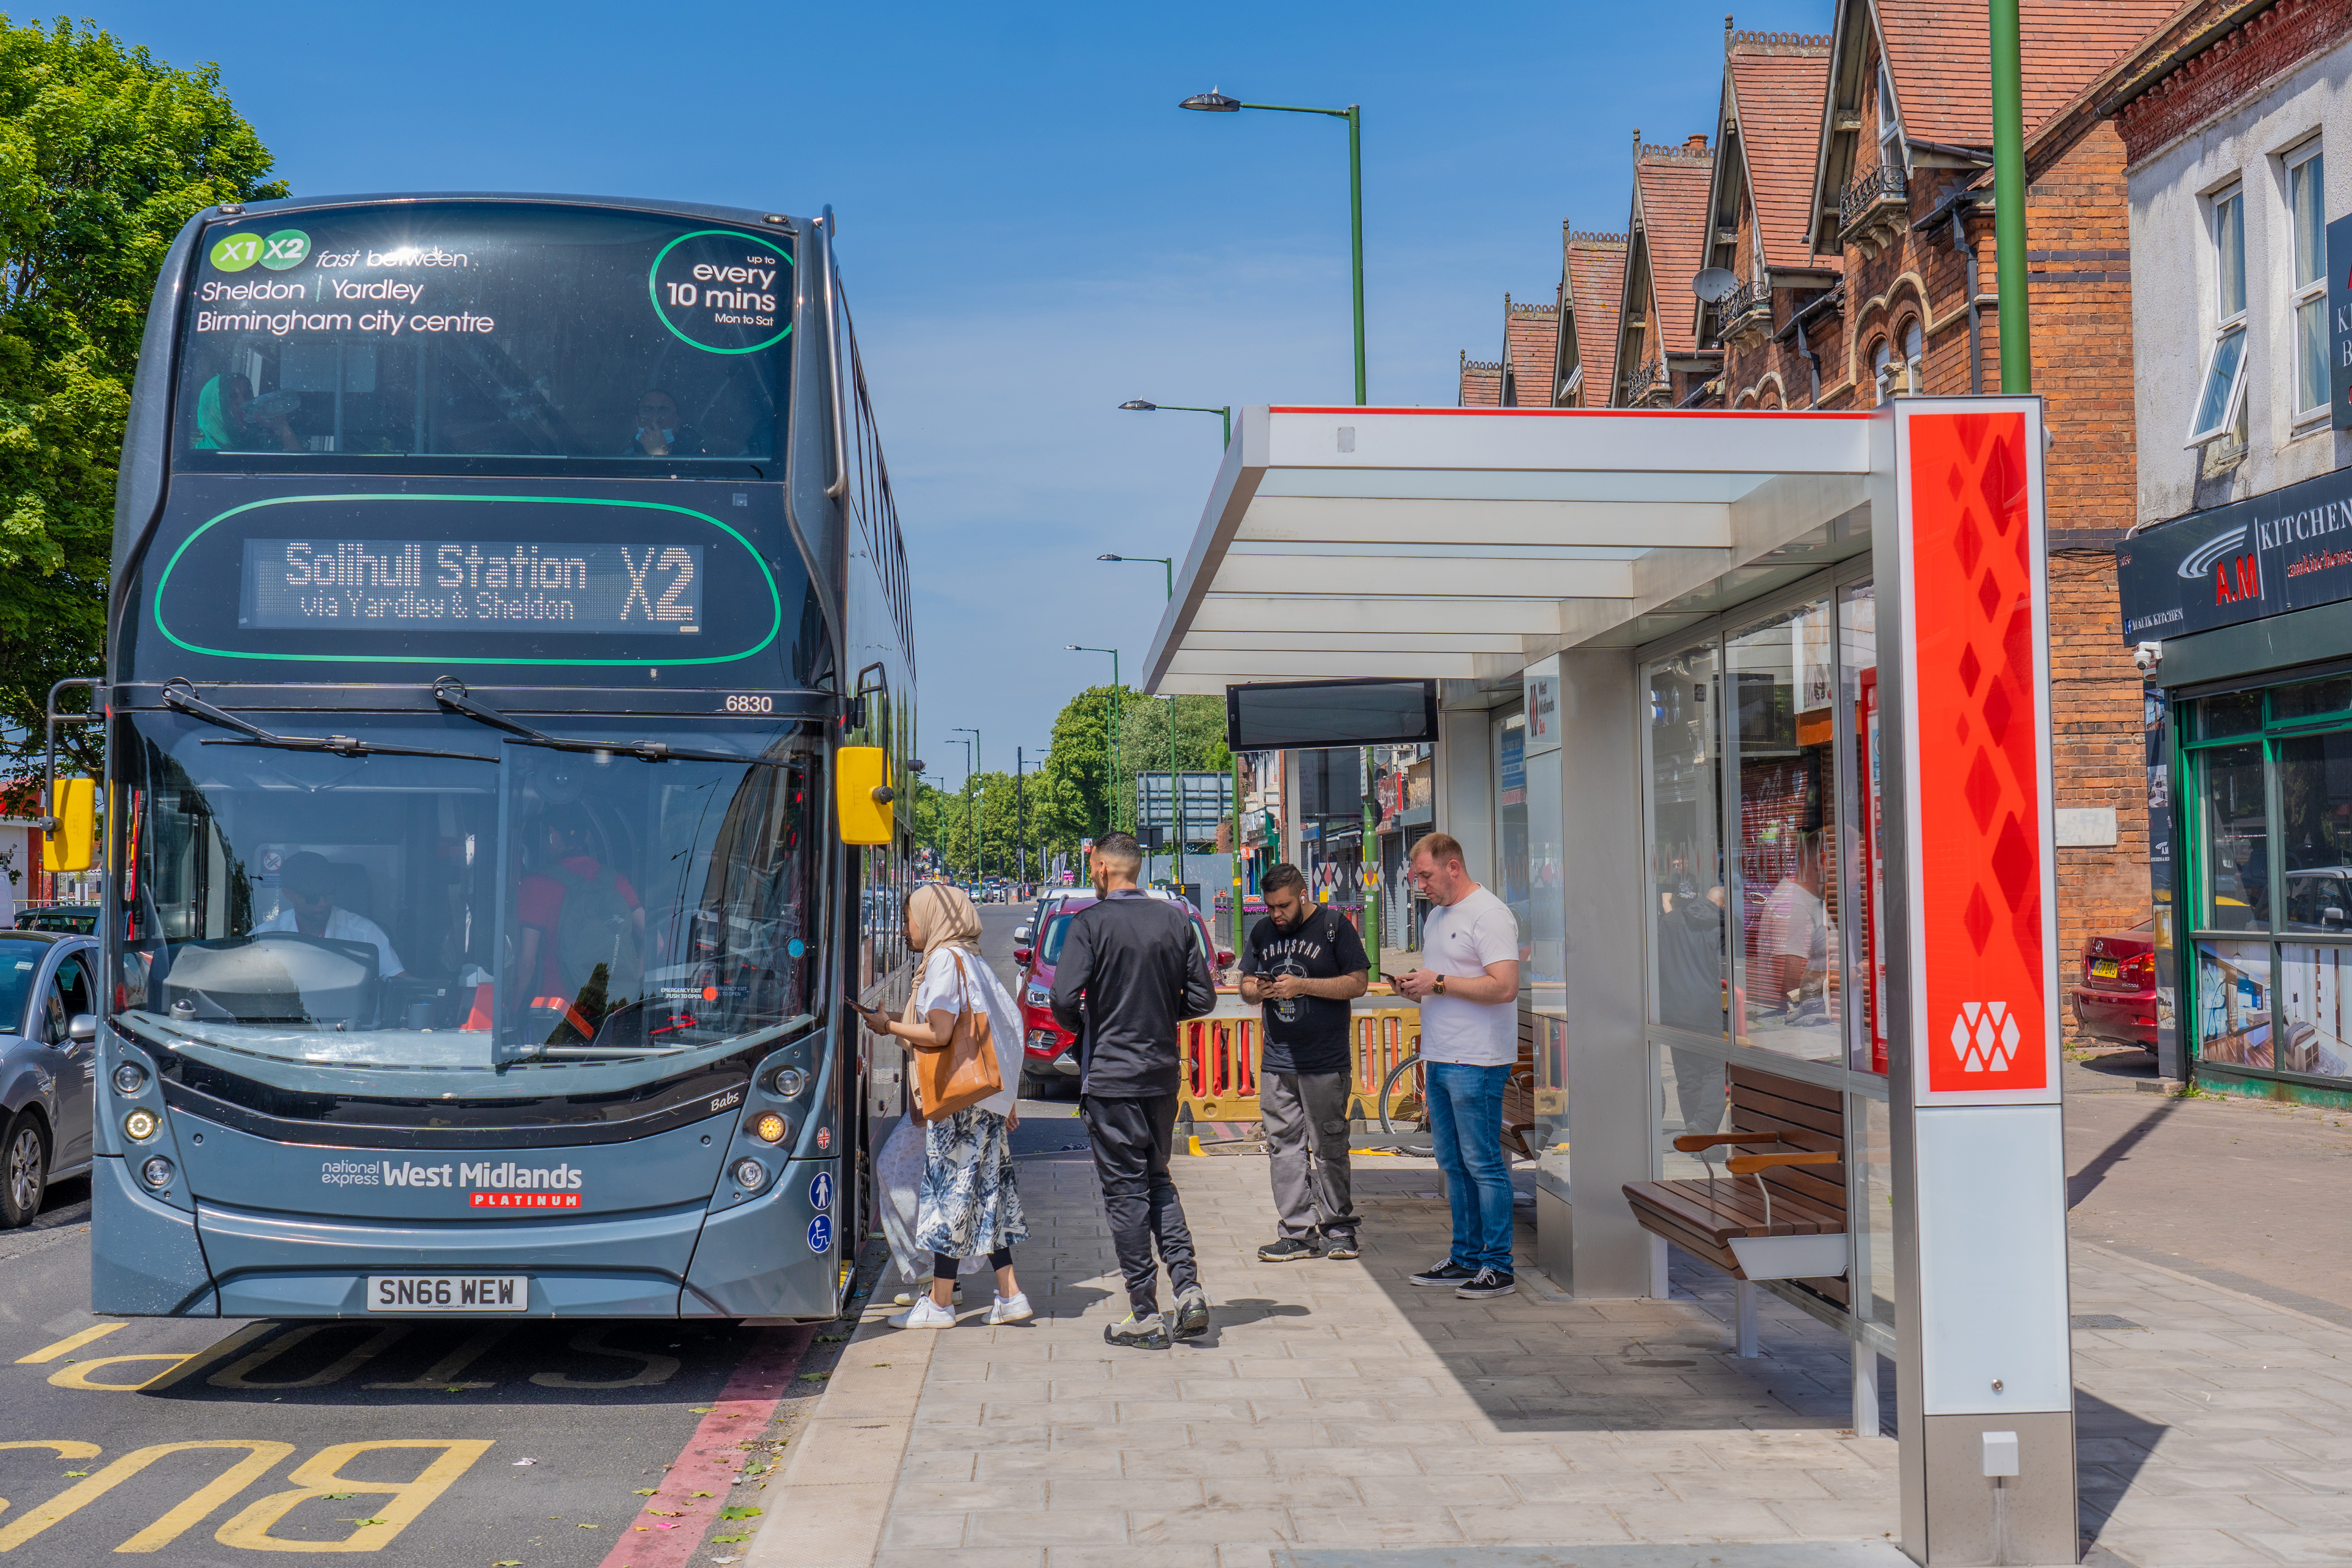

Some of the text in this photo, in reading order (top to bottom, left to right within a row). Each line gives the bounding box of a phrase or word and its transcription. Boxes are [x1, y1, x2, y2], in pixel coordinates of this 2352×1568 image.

[219, 238, 303, 261] X1 X2
[315, 250, 361, 268] fast
[747, 256, 775, 265] up to
[693, 264, 776, 290] every
[201, 279, 424, 304] Sheldon Yardley
[667, 282, 776, 312] 10 mins
[197, 310, 494, 336] Birmingham city centre
[715, 313, 774, 326] Mon to Sat
[287, 543, 586, 588] Solihull Station
[620, 547, 694, 621] X2
[2216, 552, 2259, 606] A.M
[301, 590, 573, 619] via Yardley & Sheldon
[2131, 615, 2153, 631] MALIK
[2152, 607, 2183, 626] KITCHEN
[1538, 681, 1547, 696] West
[726, 695, 773, 712] 6830
[1539, 695, 1554, 716] Midlands
[1263, 938, 1321, 961] TRAPSTAR
[711, 1092, 739, 1111] Babs
[322, 1159, 379, 1174] national
[383, 1161, 583, 1189] West Midlands
[321, 1173, 379, 1187] express
[475, 1194, 577, 1206] PLATINUM
[379, 1279, 515, 1305] SN66 WEW
[0, 1439, 495, 1553] BU
